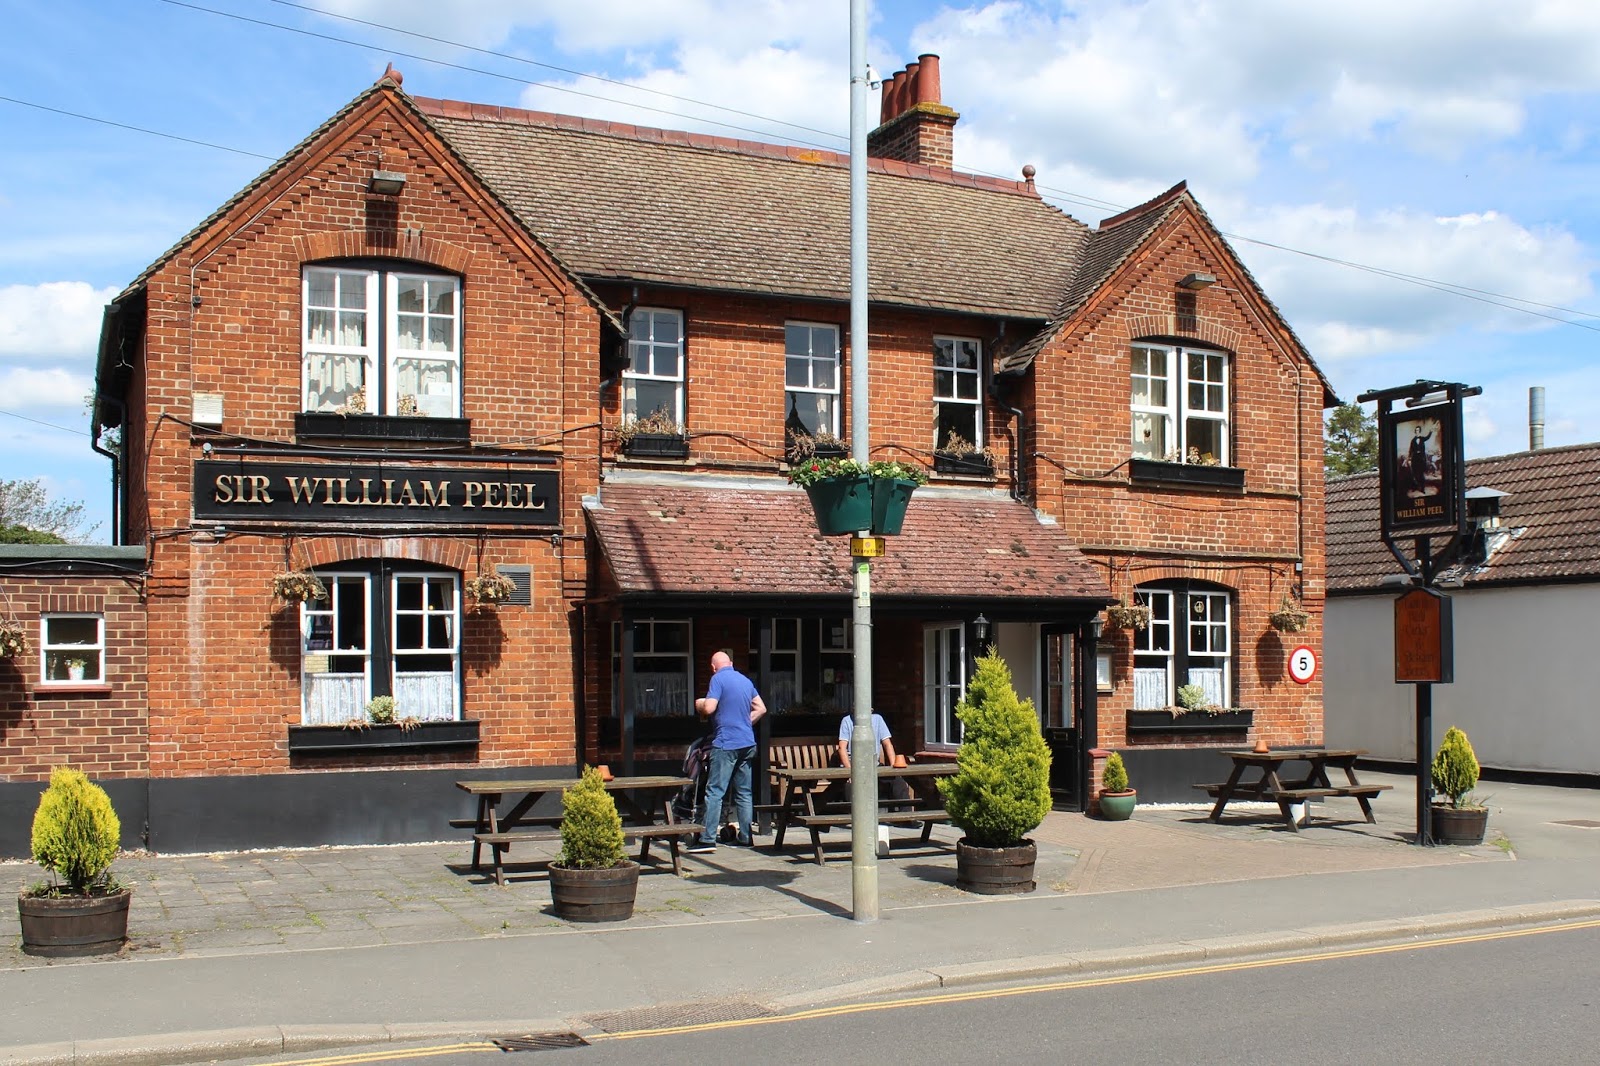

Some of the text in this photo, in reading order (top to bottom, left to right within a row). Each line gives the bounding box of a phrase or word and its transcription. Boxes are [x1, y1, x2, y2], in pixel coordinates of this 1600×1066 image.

[215, 474, 546, 510] SIR WILLIAM PEEL
[1413, 498, 1425, 507] SIR
[1396, 505, 1444, 518] WILLIAM PEEL
[1299, 657, 1307, 670] 5
